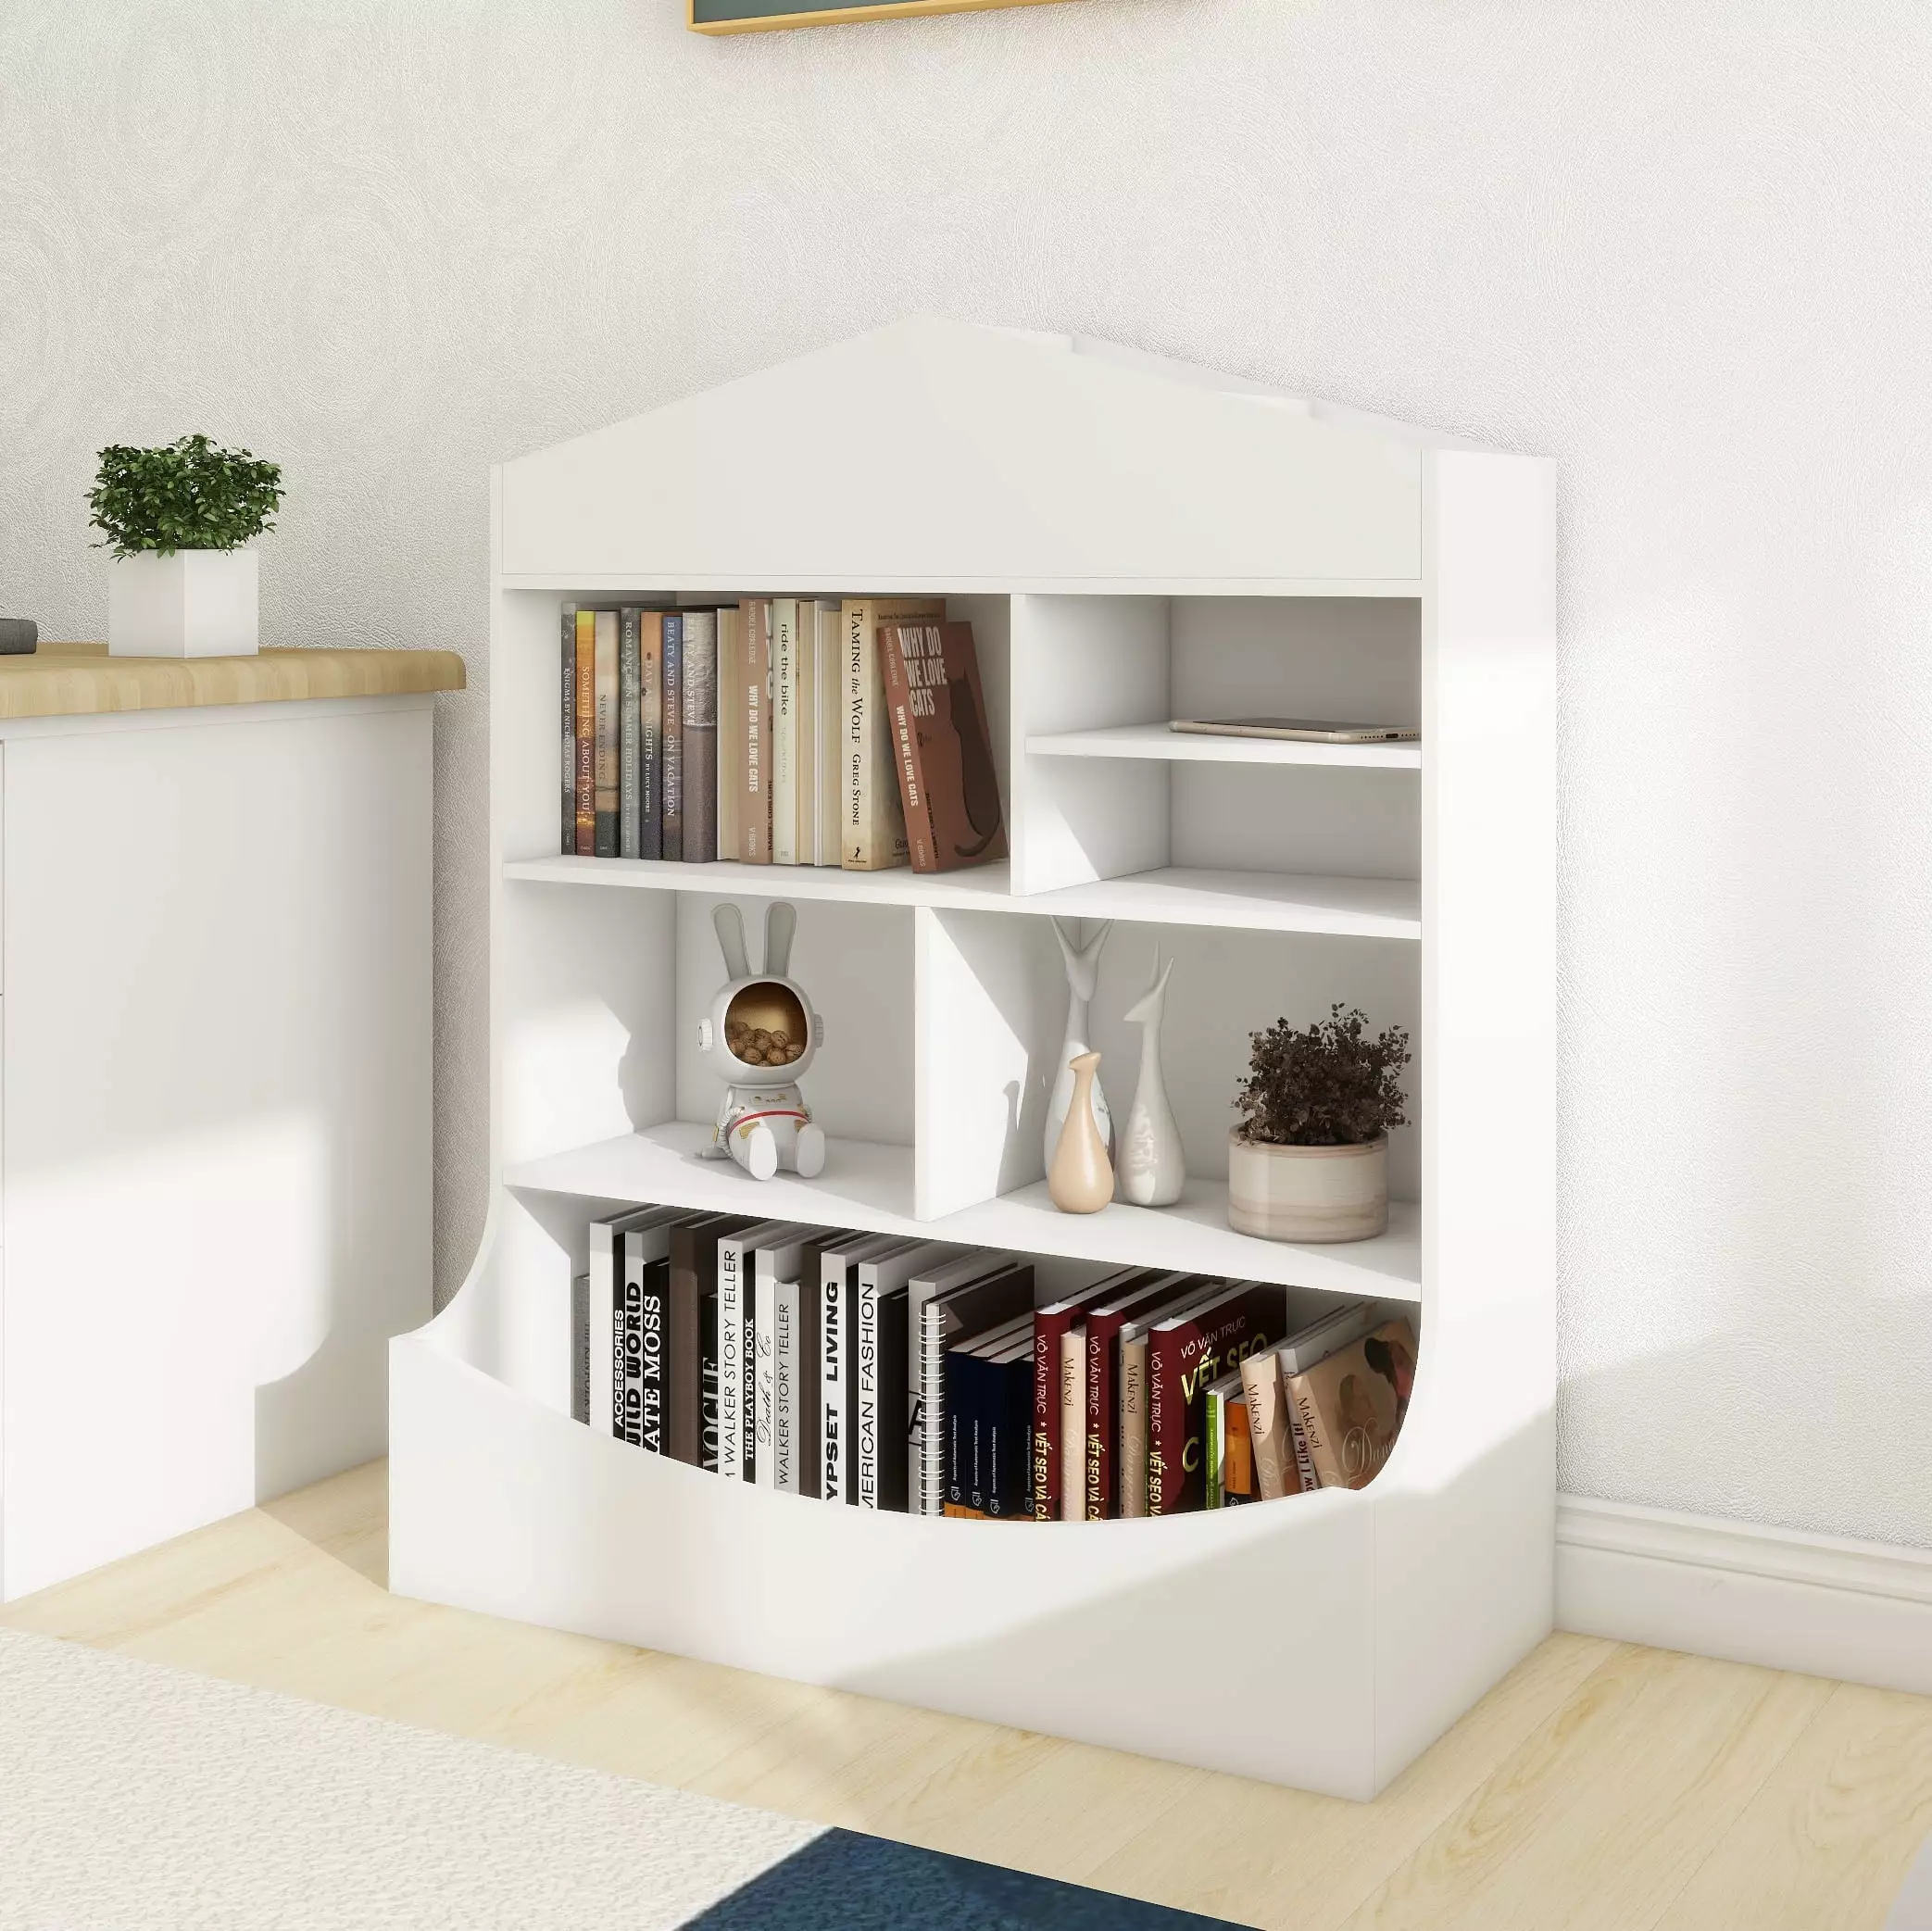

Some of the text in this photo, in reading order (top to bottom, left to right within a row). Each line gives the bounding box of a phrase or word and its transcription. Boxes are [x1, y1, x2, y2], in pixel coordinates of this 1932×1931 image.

[667, 621, 675, 658] BEATY
[897, 626, 942, 658] WHY DO
[667, 660, 675, 686] AND
[852, 678, 861, 695] the
[904, 658, 947, 687] WE LOVE
[563, 704, 571, 714] BY
[667, 689, 675, 725] STEVE
[910, 688, 935, 717] CATS
[582, 666, 590, 811] SOMETHING ABOUT YOU
[598, 694, 608, 780] NEVER ENDING
[667, 735, 675, 752] ON
[748, 685, 759, 792] WHY DO WE LOVE CATS
[896, 706, 918, 806] WHY DO WE LOVE CATS
[667, 756, 675, 817] VACATION
[724, 1250, 735, 1311] TELLER
[626, 1282, 641, 1379] WORLD
[757, 1333, 771, 1358] Co
[826, 1281, 838, 1381] LIVING
[862, 1283, 874, 1391] FASHION
[1198, 1331, 1218, 1351] VĂN
[724, 1319, 735, 1380] STORY
[615, 1310, 624, 1427] ACCESSORIES
[644, 1295, 660, 1451] ATE MOSS
[1037, 1357, 1048, 1387] VĂN
[1089, 1357, 1100, 1384] VĂN
[1151, 1373, 1162, 1399] VĂN
[745, 1318, 754, 1460] THE PLAYBOY BOOK
[779, 1304, 789, 1484] WALKER STORY TELLER
[724, 1387, 735, 1463] WALKER
[758, 1382, 772, 1447] Death
[1293, 1423, 1304, 1436] It!
[1297, 1440, 1310, 1463] Like
[1035, 1484, 1051, 1502] VÀ
[1088, 1487, 1103, 1501] VÀ
[1035, 1504, 1051, 1520] CÁ
